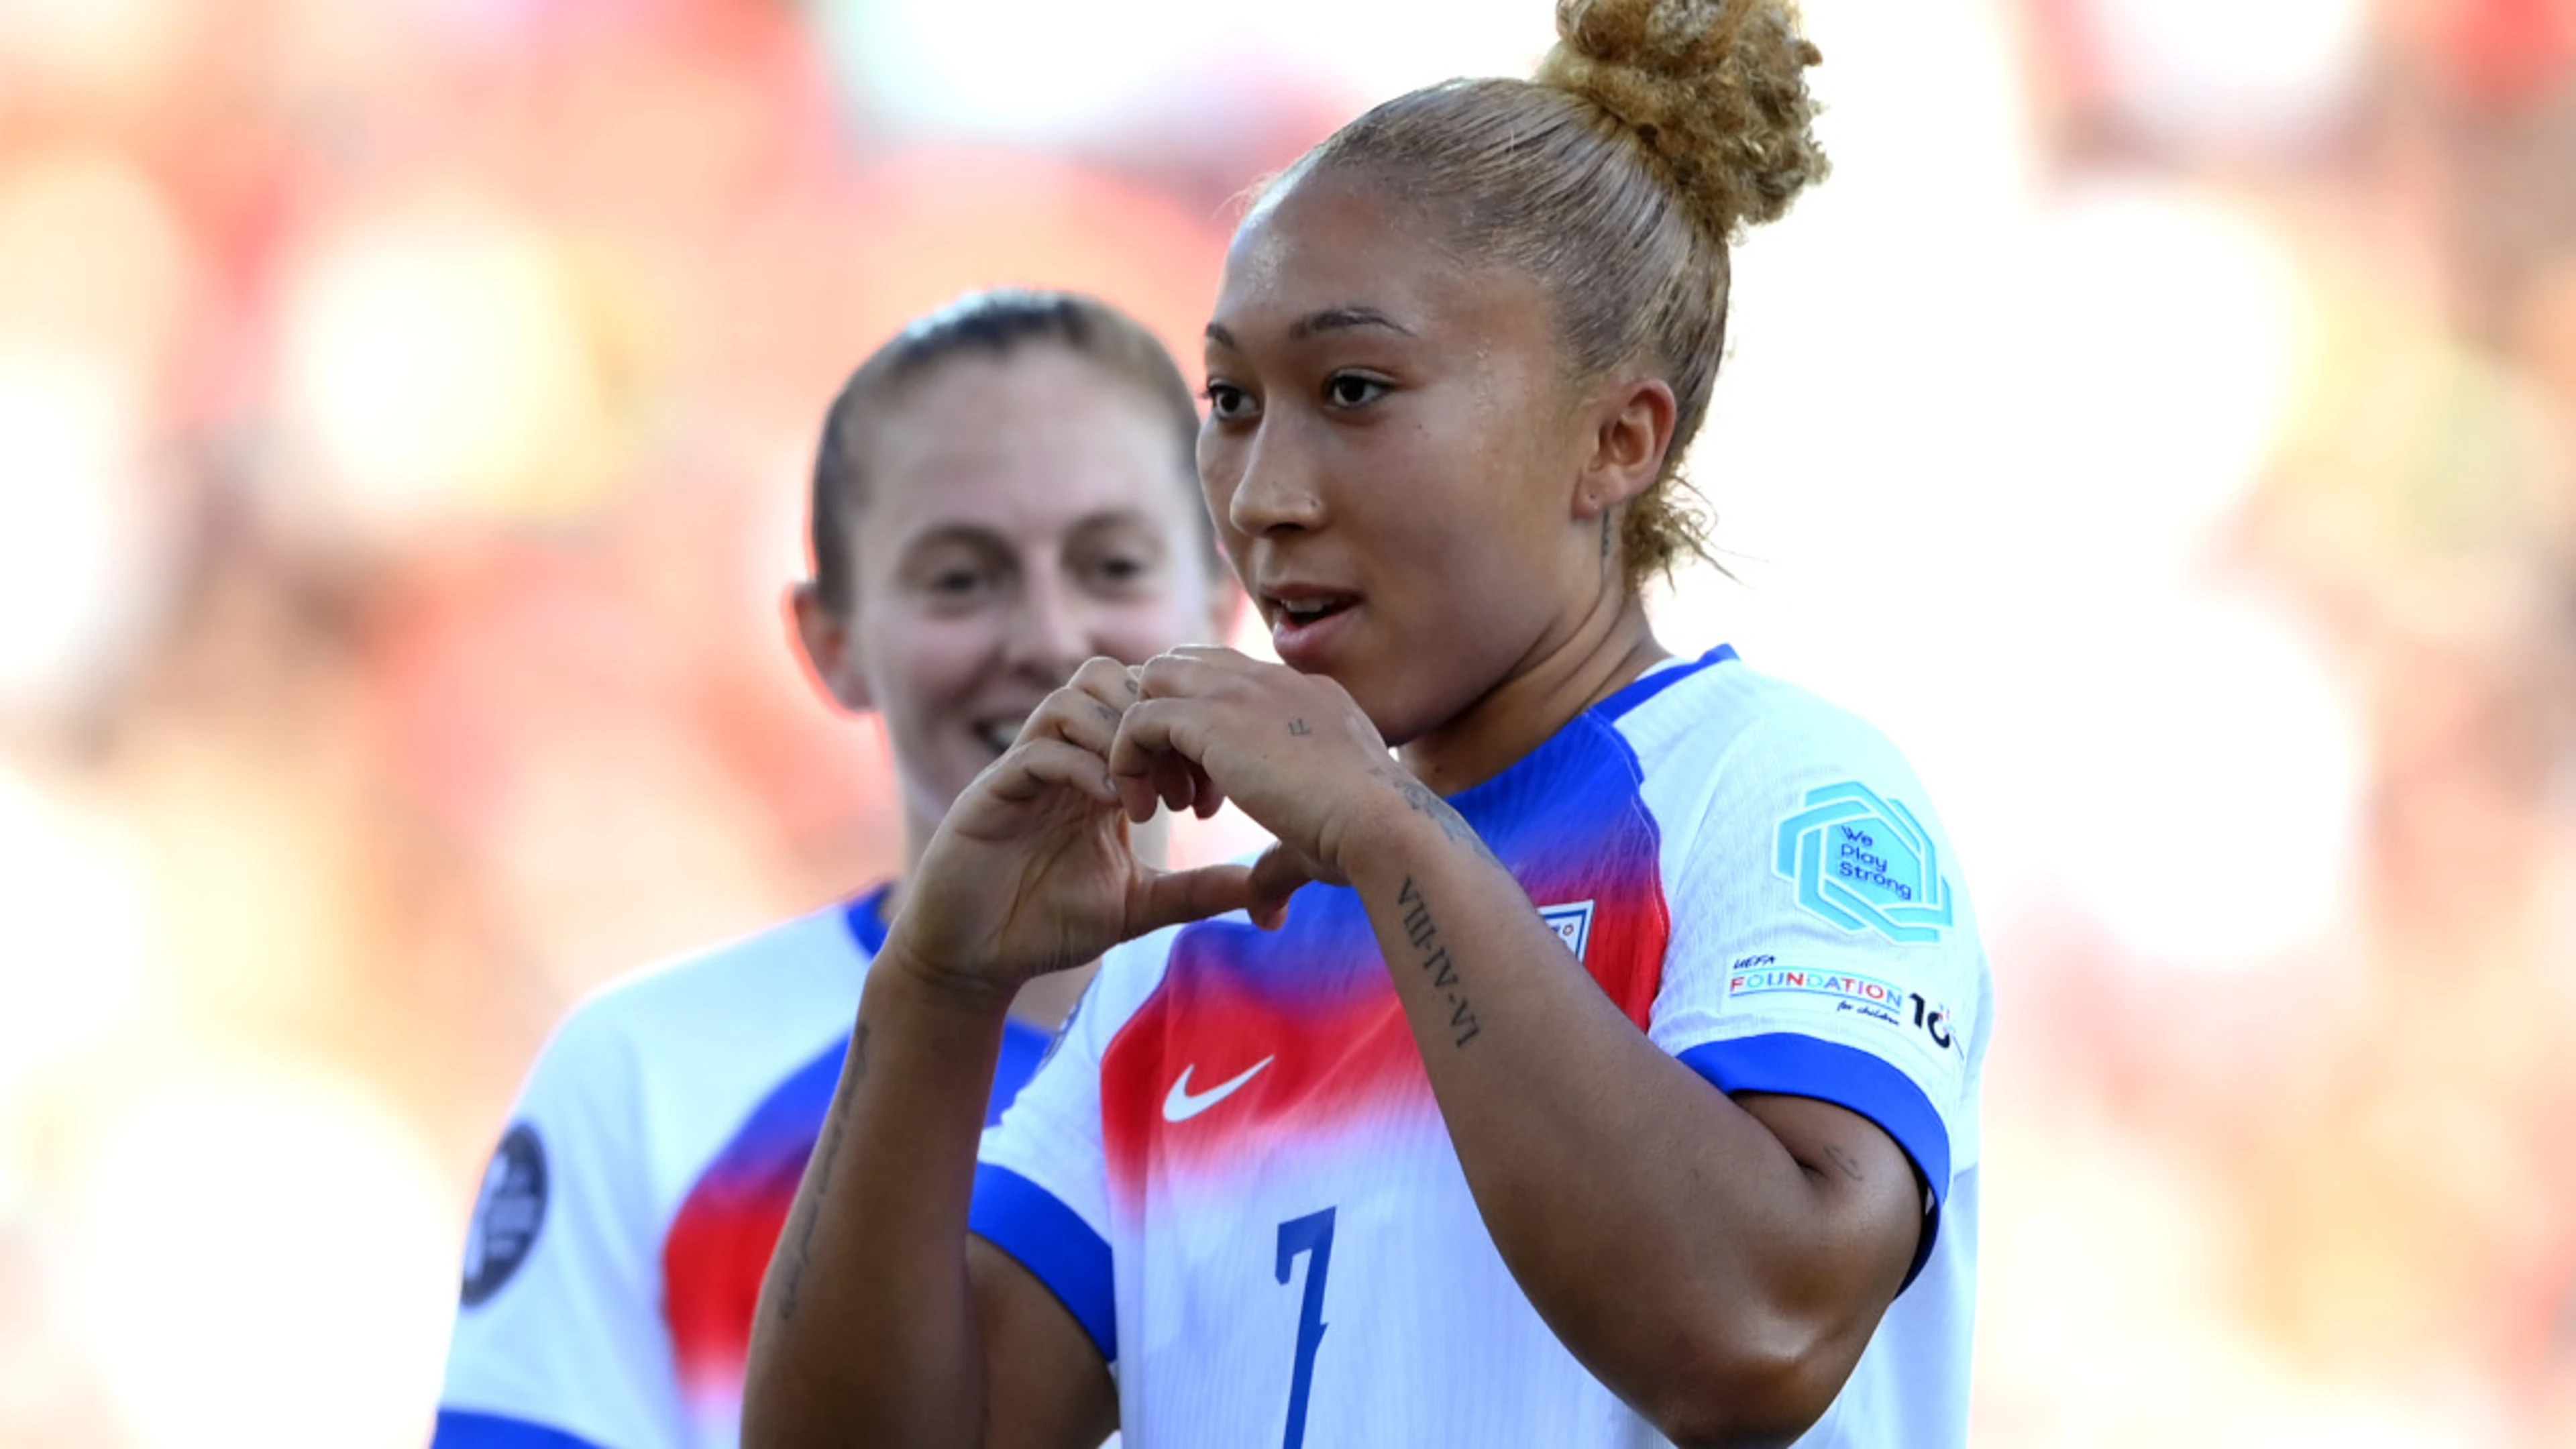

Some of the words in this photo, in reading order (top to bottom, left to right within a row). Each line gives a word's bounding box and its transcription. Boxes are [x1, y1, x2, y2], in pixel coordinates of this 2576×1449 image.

[1841, 824, 1873, 847] We
[1839, 861, 1912, 901] Strong
[1733, 955, 1776, 969] UEFA
[1729, 971, 1902, 1008] FOUNDATION
[1275, 1205, 1337, 1449] 7
